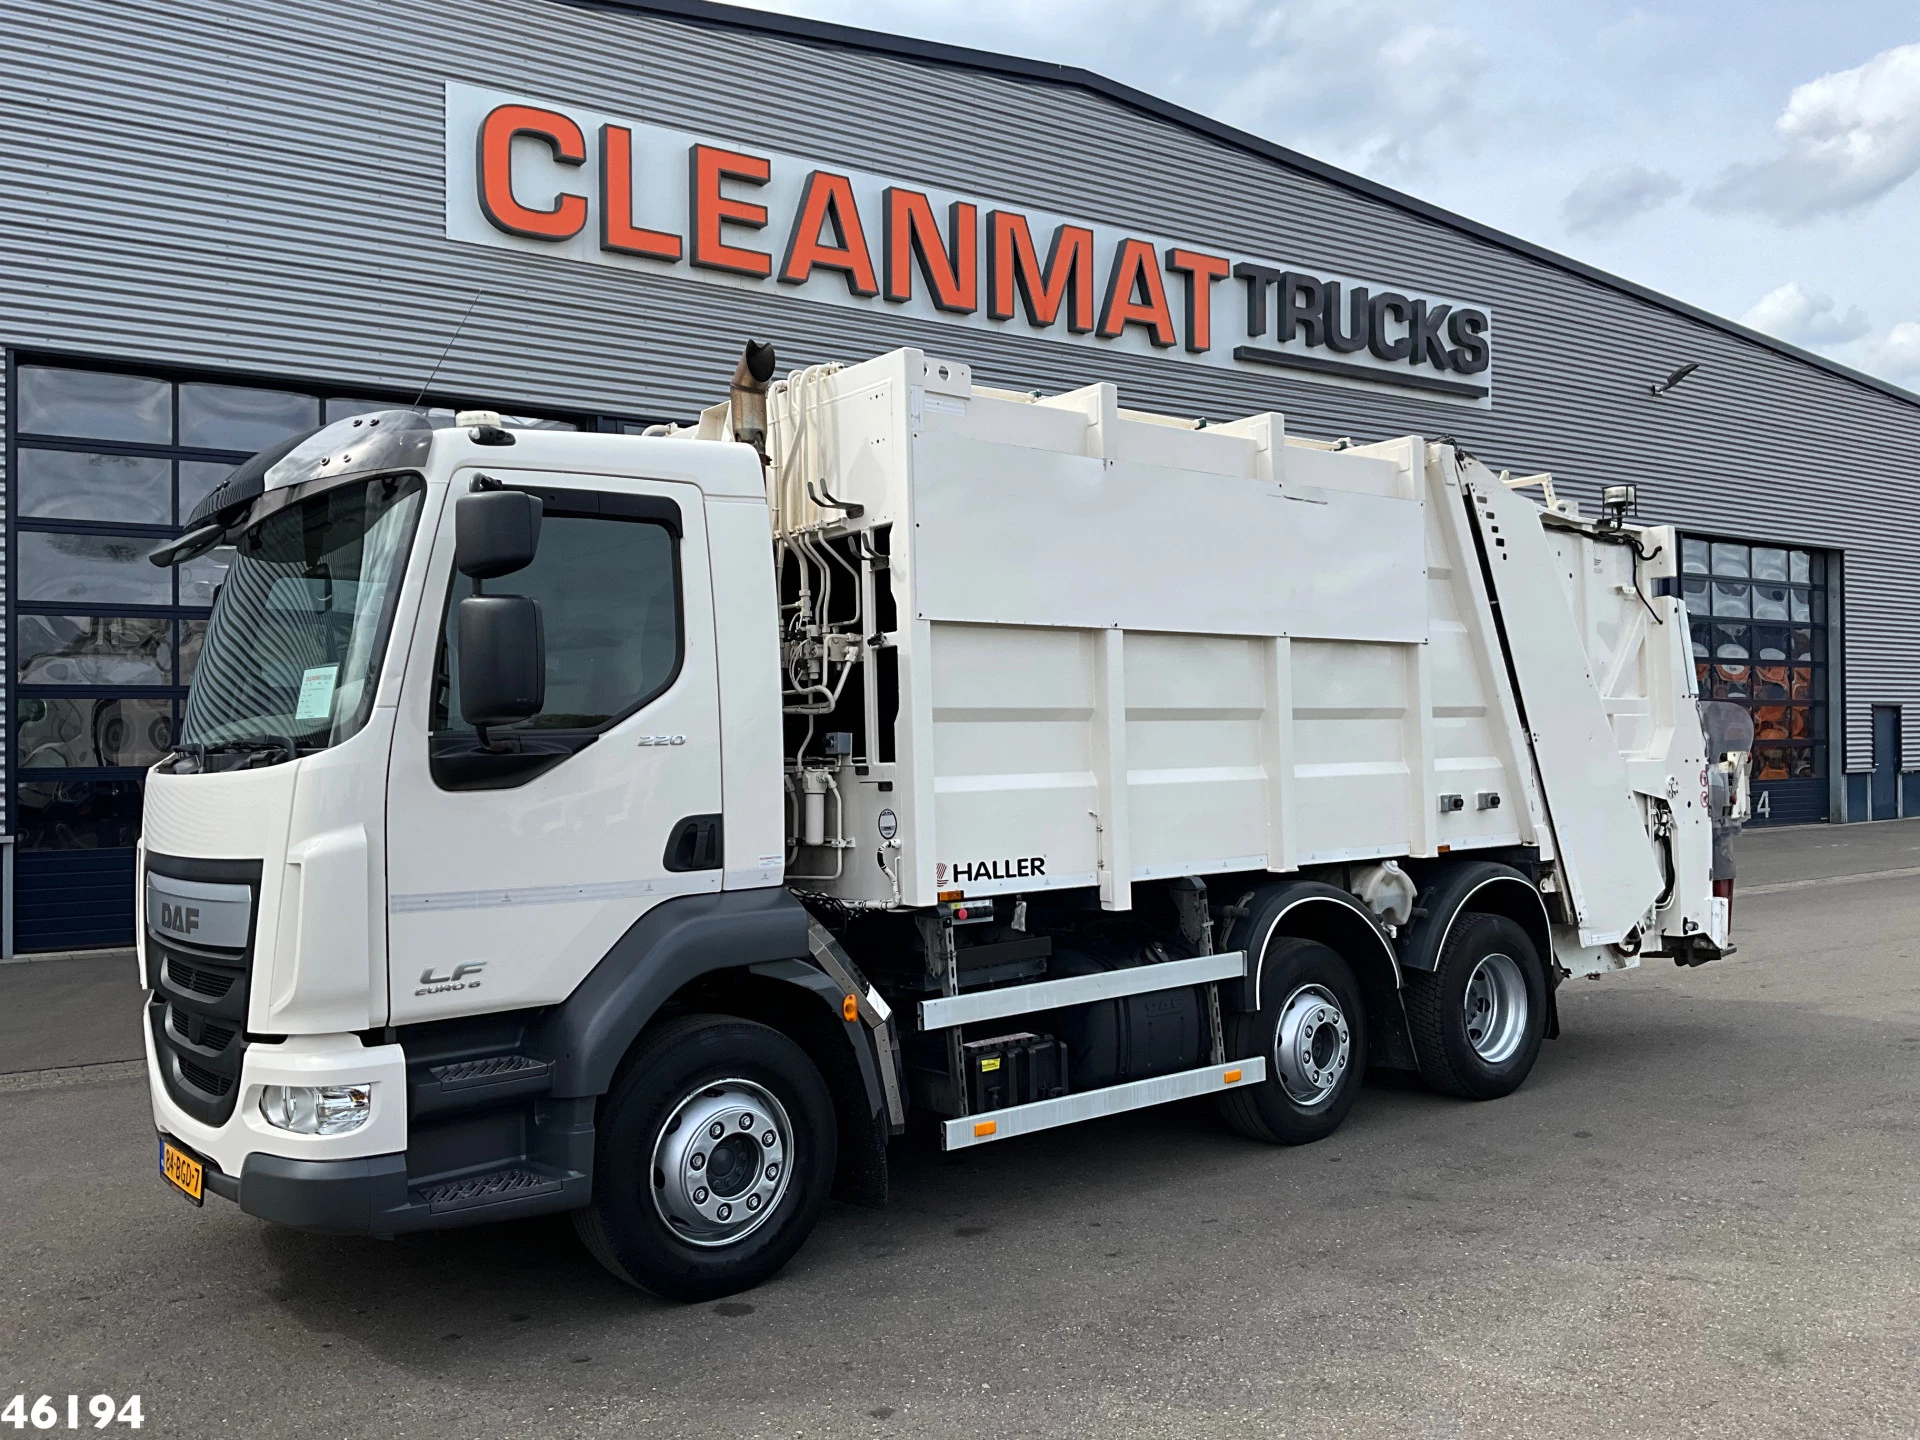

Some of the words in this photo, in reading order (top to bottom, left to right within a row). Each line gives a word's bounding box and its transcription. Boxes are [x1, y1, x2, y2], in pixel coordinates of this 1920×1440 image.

[476, 103, 1230, 352] CLEANMAT
[1233, 261, 1490, 375] TRUCKS
[637, 734, 687, 747] 220
[1757, 790, 1771, 818] 4
[953, 857, 1046, 883] HALLER
[161, 902, 200, 934] DAF
[420, 960, 488, 985] LF
[414, 982, 465, 996] EURO
[468, 980, 481, 989] 6
